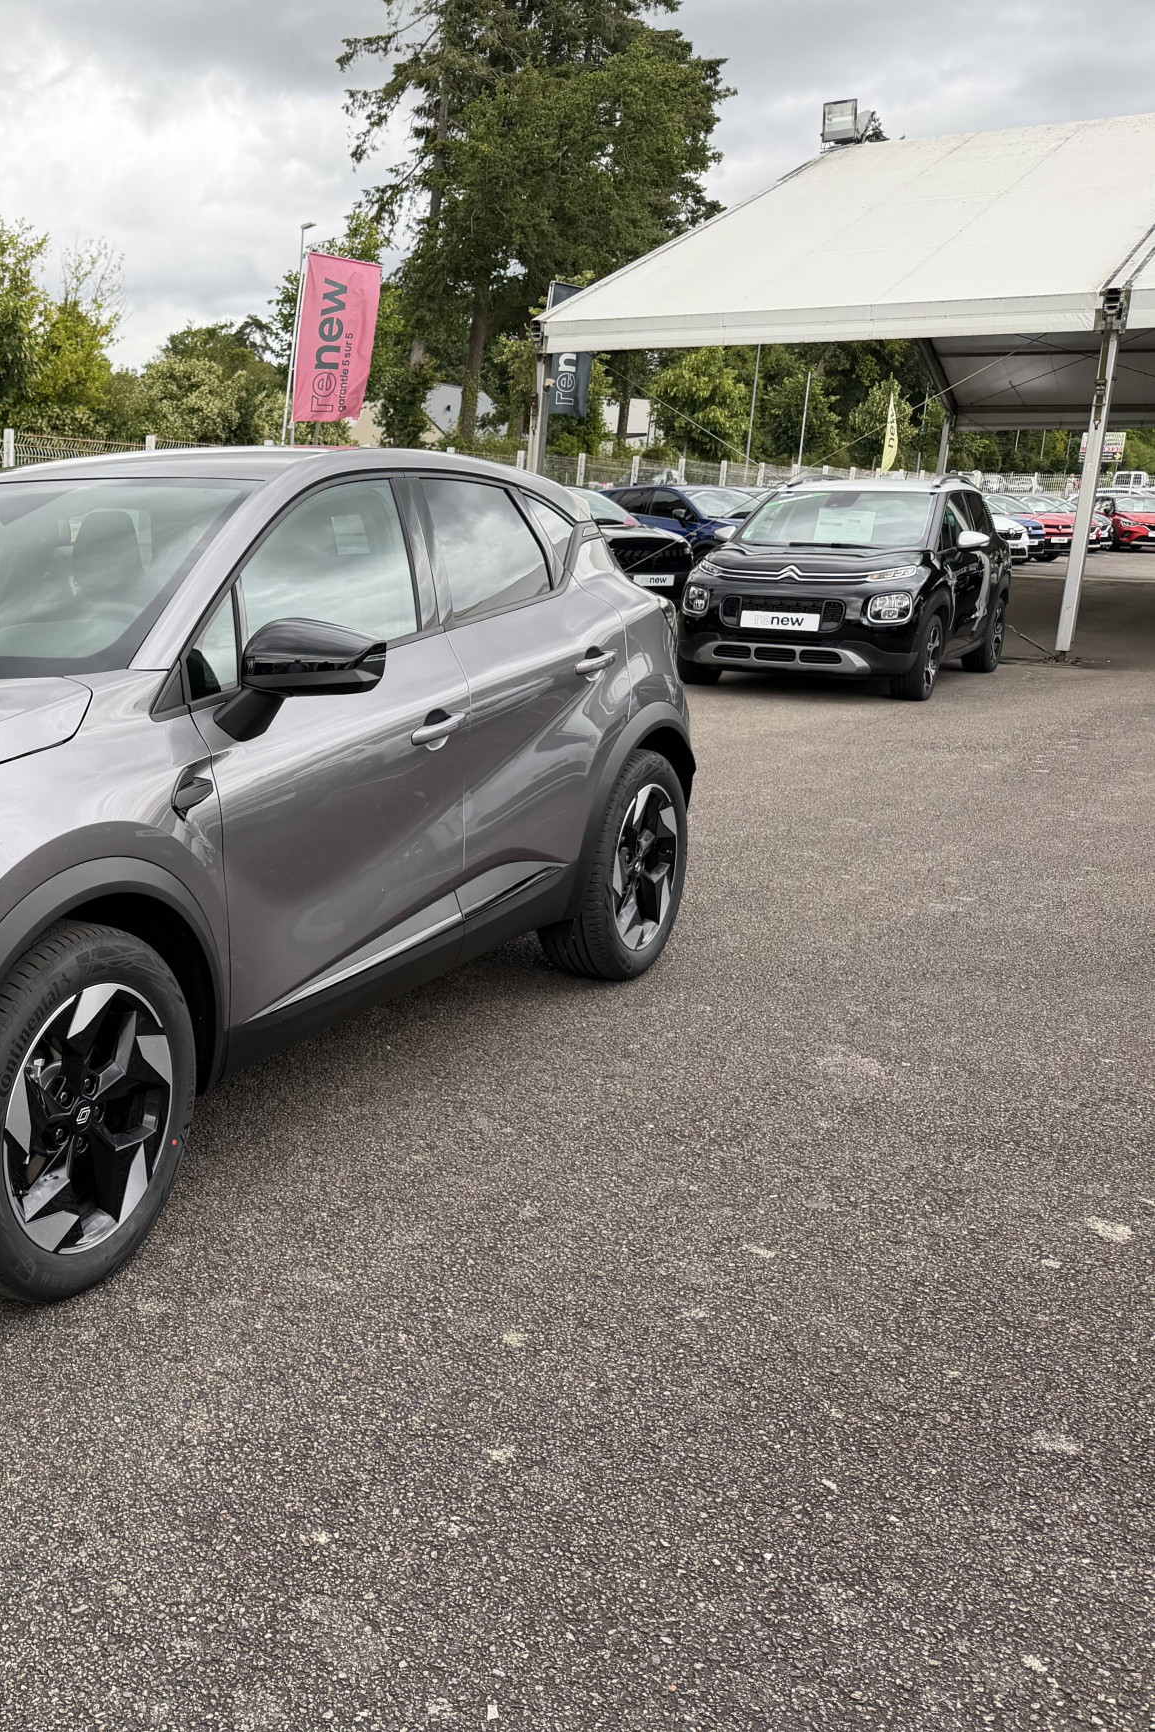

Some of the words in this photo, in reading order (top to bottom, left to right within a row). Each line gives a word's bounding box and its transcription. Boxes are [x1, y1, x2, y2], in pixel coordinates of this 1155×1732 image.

[346, 332, 353, 340] 5
[310, 276, 349, 413] renew
[344, 340, 353, 358] sur
[341, 359, 350, 367] 5
[337, 367, 349, 413] garantie
[754, 614, 805, 627] renew
